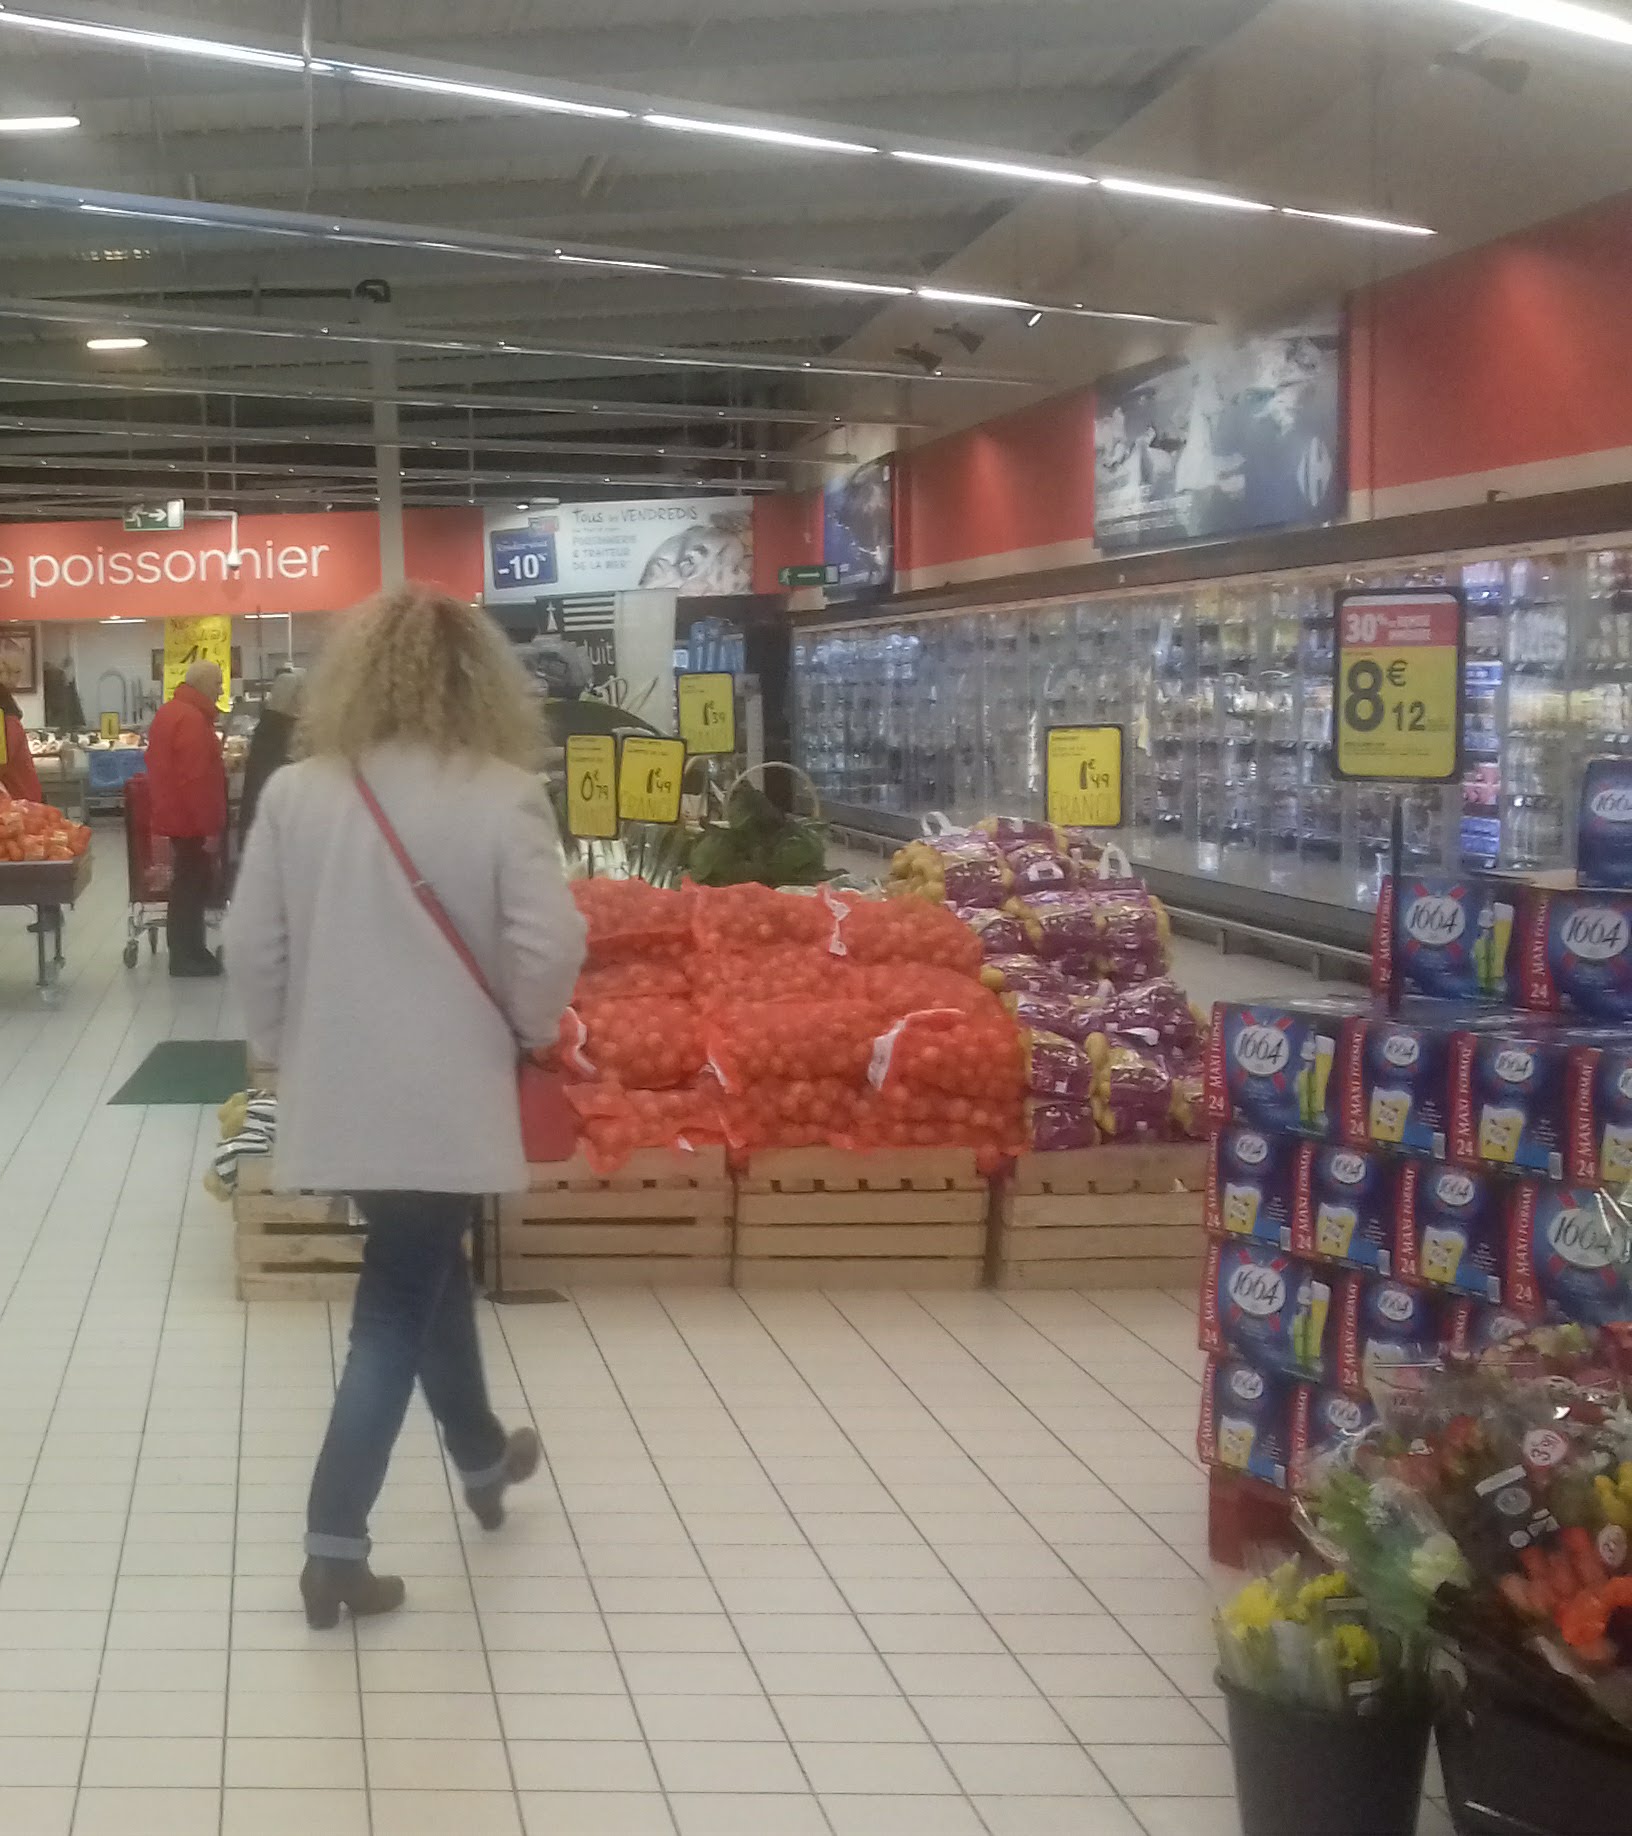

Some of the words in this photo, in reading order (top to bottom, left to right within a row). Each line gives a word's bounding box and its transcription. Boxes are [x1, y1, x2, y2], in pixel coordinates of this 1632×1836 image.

[621, 505, 698, 523] VENDREDIS
[27, 539, 331, 599] poissonnier
[1409, 904, 1460, 934] 1664
[1567, 915, 1623, 947] 1664
[1532, 942, 1546, 977] MAXI
[1529, 982, 1548, 1000] 24
[1238, 1030, 1285, 1066] 1664
[1209, 1058, 1222, 1089] MAXI
[1208, 1094, 1226, 1112] 24
[1350, 1084, 1362, 1119] MAXI
[1349, 1119, 1366, 1137] 24
[1457, 1099, 1471, 1138] MAXI
[1456, 1138, 1474, 1157] 24
[1578, 1117, 1593, 1157] MAXI
[1577, 1160, 1595, 1179] 24
[1516, 1240, 1531, 1278] MAXI
[1233, 1270, 1281, 1306] 1664
[1515, 1283, 1533, 1302] 24
[1343, 1331, 1356, 1368] MAXI
[1343, 1367, 1358, 1387] 24
